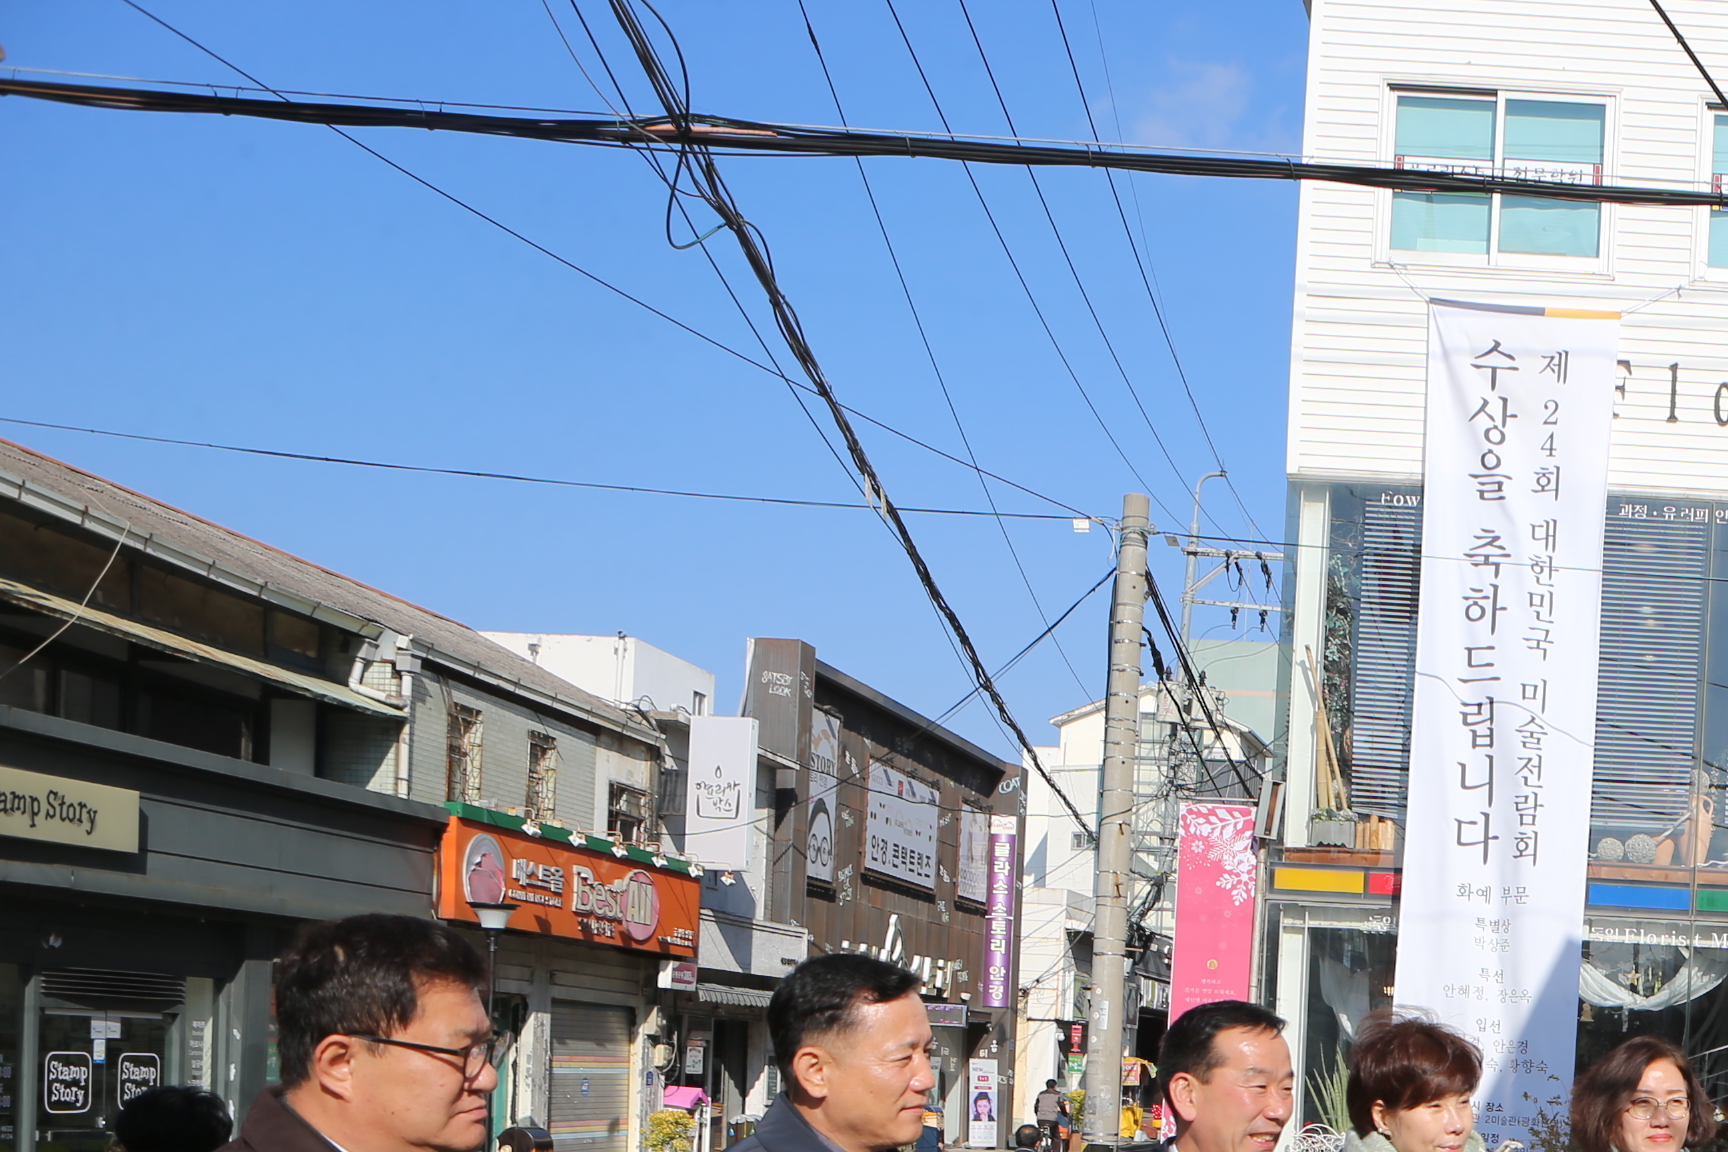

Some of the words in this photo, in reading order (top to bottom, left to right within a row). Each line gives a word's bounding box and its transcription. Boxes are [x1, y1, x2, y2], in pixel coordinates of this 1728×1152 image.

[1467, 339, 1520, 501] 수상을
[1619, 503, 1648, 519] 과정
[1521, 517, 1559, 661] 대한민국
[1453, 527, 1512, 866] 축하드립니다
[1511, 679, 1549, 868] 미술전람회
[45, 789, 98, 835] Story
[512, 858, 564, 893] 베스트올
[1455, 882, 1492, 904] 화예
[1501, 886, 1530, 905] 부문
[1474, 917, 1512, 934] 특별상
[1474, 935, 1511, 953] 박상준
[989, 966, 1007, 1001] 안경
[1478, 968, 1505, 984] 특선
[1496, 988, 1533, 1004] 장은옥
[1475, 1018, 1501, 1035] 입선
[1493, 1039, 1528, 1055] 안은경
[49, 1061, 88, 1086] Stamp
[121, 1062, 157, 1086] Stamp
[1509, 1059, 1549, 1075] 황향숙
[51, 1083, 85, 1106] Story
[1485, 1102, 1504, 1112] 장소
